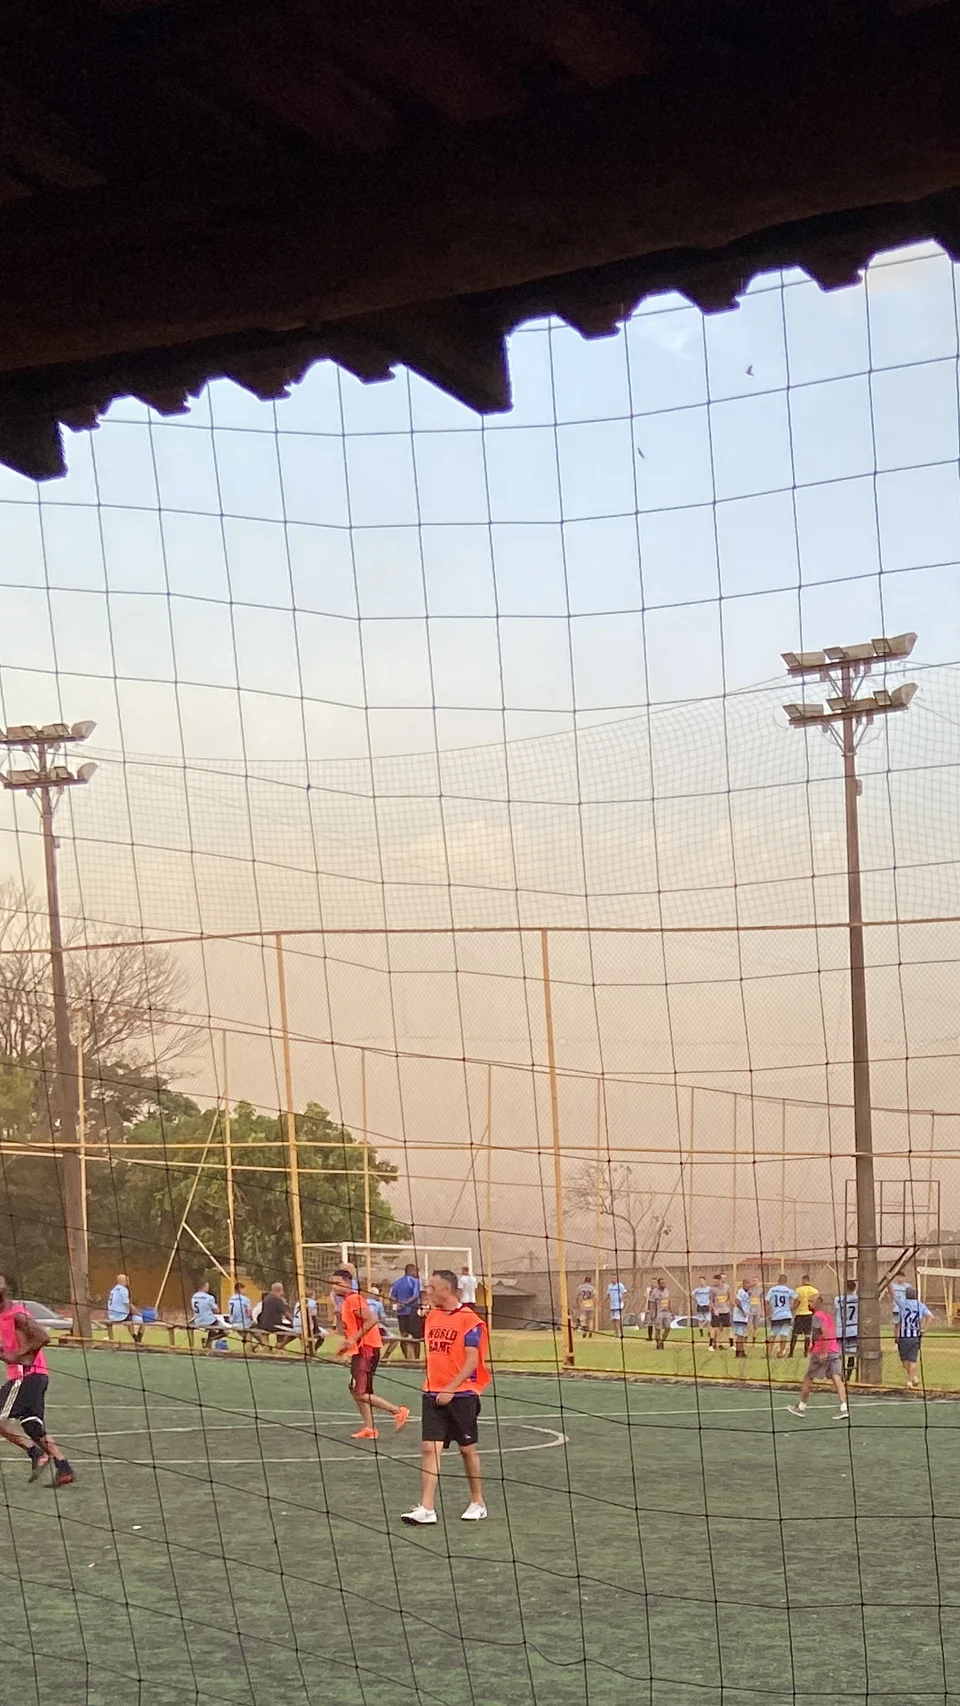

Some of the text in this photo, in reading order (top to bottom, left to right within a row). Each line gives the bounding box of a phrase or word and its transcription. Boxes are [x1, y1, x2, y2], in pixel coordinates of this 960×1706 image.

[193, 1301, 200, 1314] 5
[774, 1294, 786, 1308] 19
[428, 1328, 458, 1341] WORLD
[429, 1340, 451, 1354] GAME
